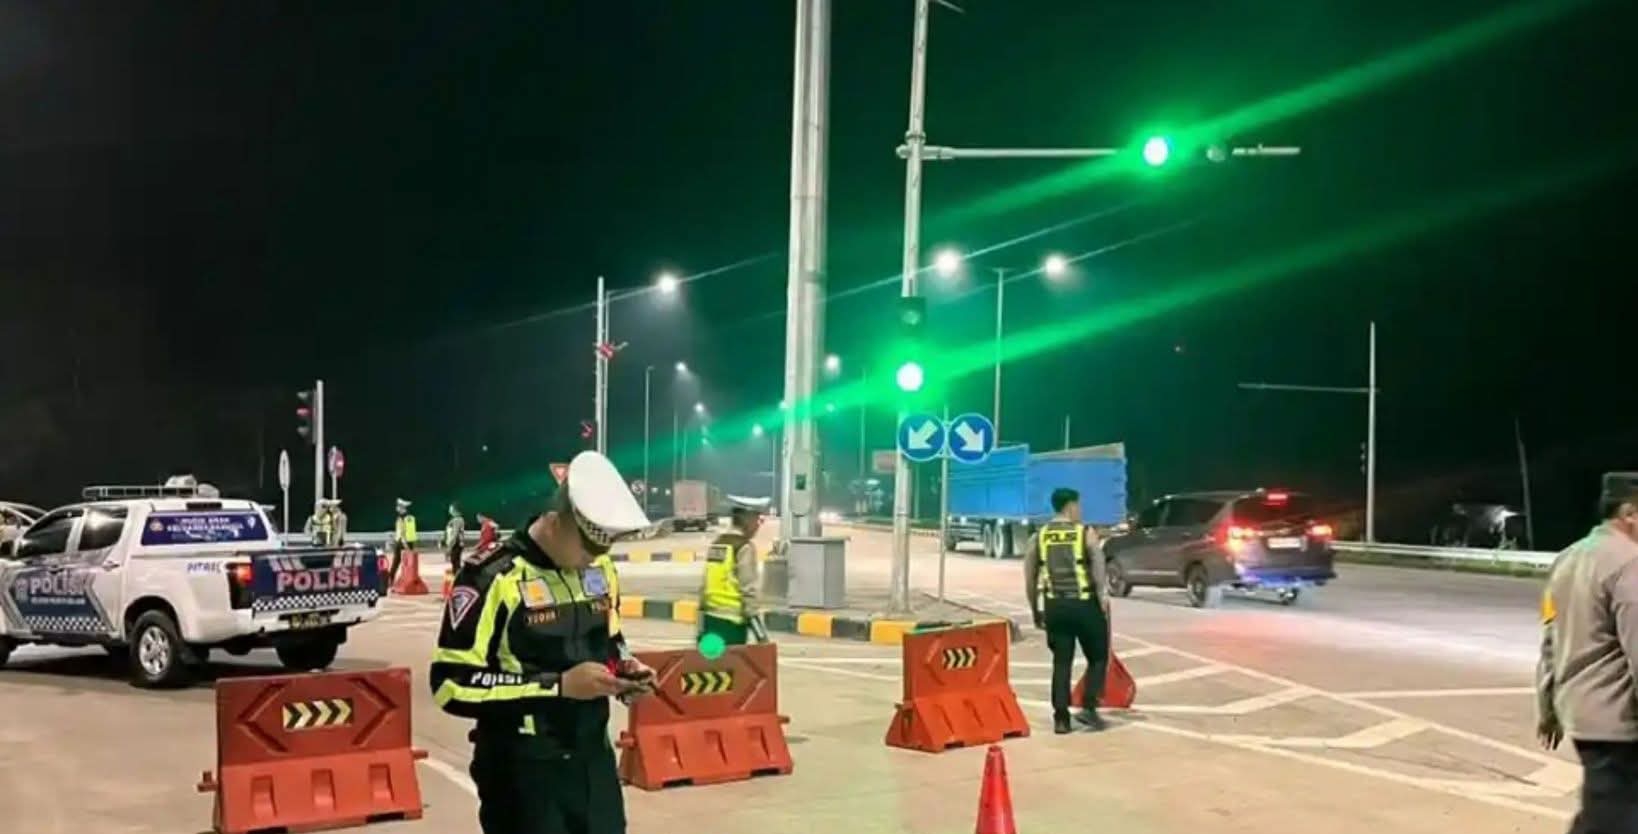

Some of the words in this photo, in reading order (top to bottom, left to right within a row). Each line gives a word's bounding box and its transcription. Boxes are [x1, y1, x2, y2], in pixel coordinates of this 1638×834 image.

[29, 573, 85, 595] POLISI
[276, 567, 360, 593] POLISI
[470, 671, 523, 686] POLISI
